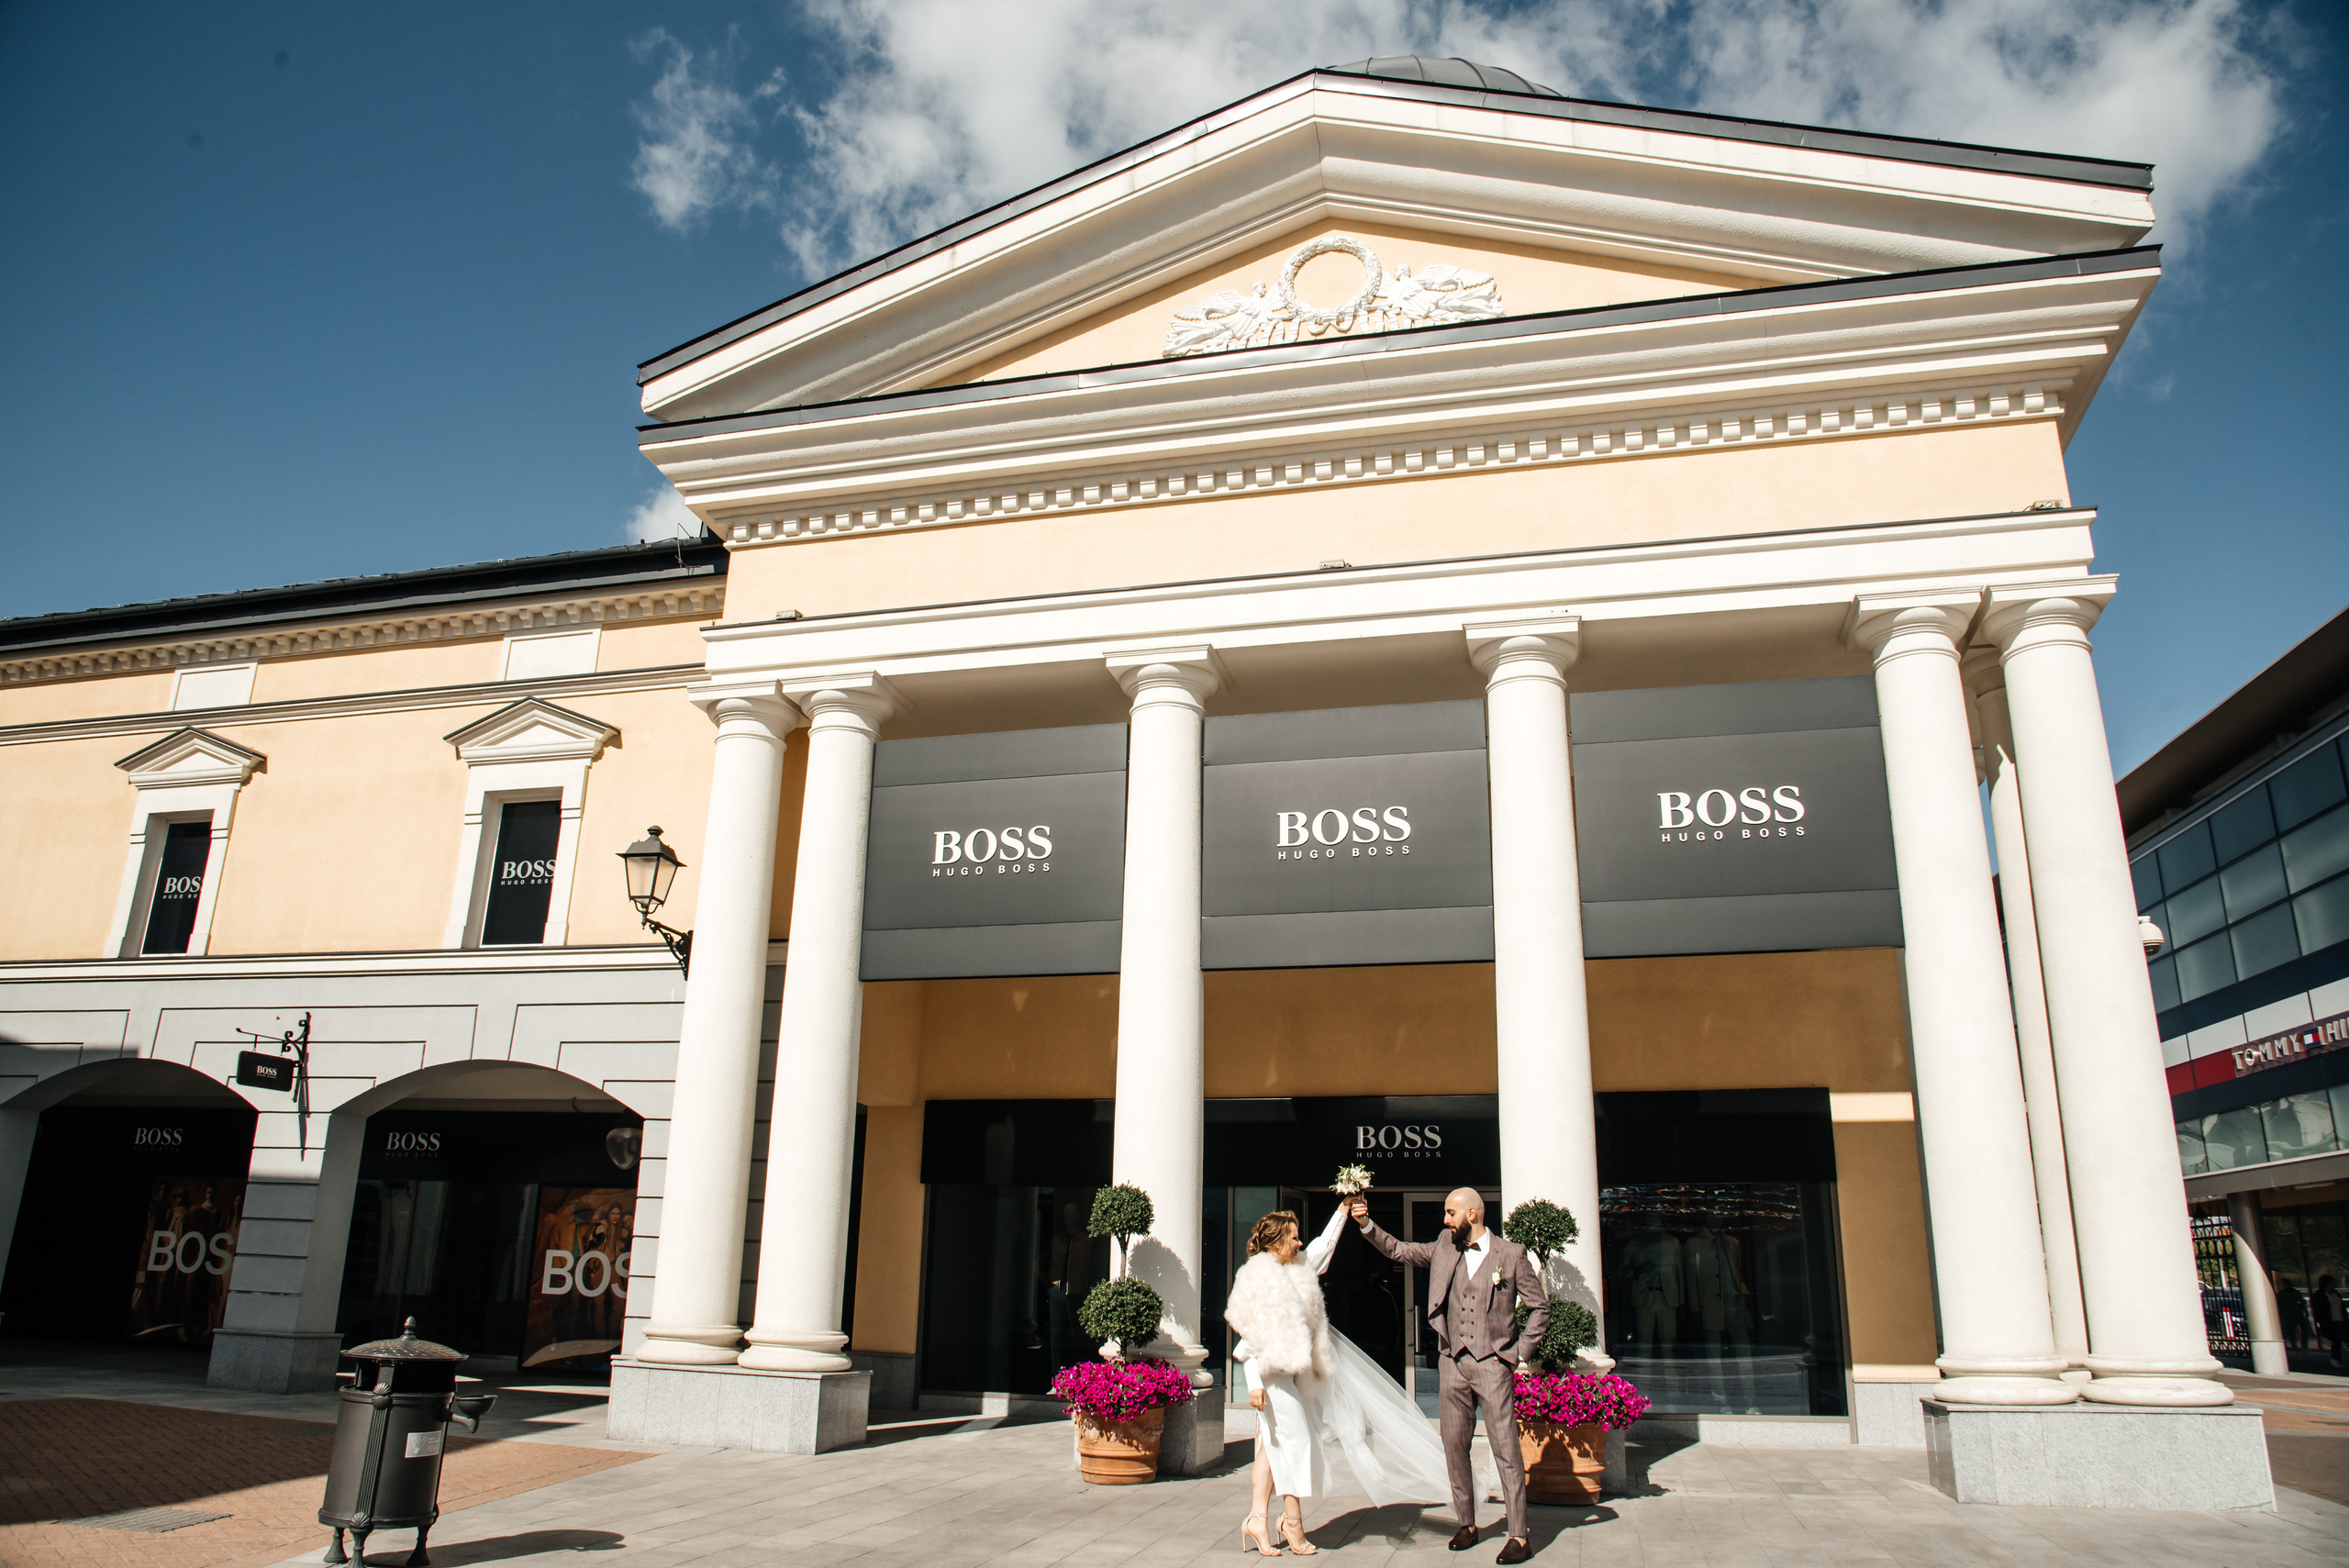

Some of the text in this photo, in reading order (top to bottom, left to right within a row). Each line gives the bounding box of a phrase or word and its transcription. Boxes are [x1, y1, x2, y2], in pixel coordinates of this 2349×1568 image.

[1656, 785, 1805, 829] BOSS
[1276, 806, 1411, 847] BOSS
[1662, 827, 1805, 843] HUGO BOSS
[931, 825, 1053, 865] BOSS
[1278, 845, 1410, 861] HUGO BOSS
[501, 859, 556, 879] BOSS
[932, 862, 1051, 877] HUGO BOSS
[164, 876, 203, 893] BOS
[2232, 1016, 2349, 1070] TOMMY HI
[257, 1065, 278, 1076] BOSS
[134, 1128, 183, 1145] BOSS
[386, 1132, 440, 1151] BOSS
[1355, 1125, 1442, 1150] BOSS
